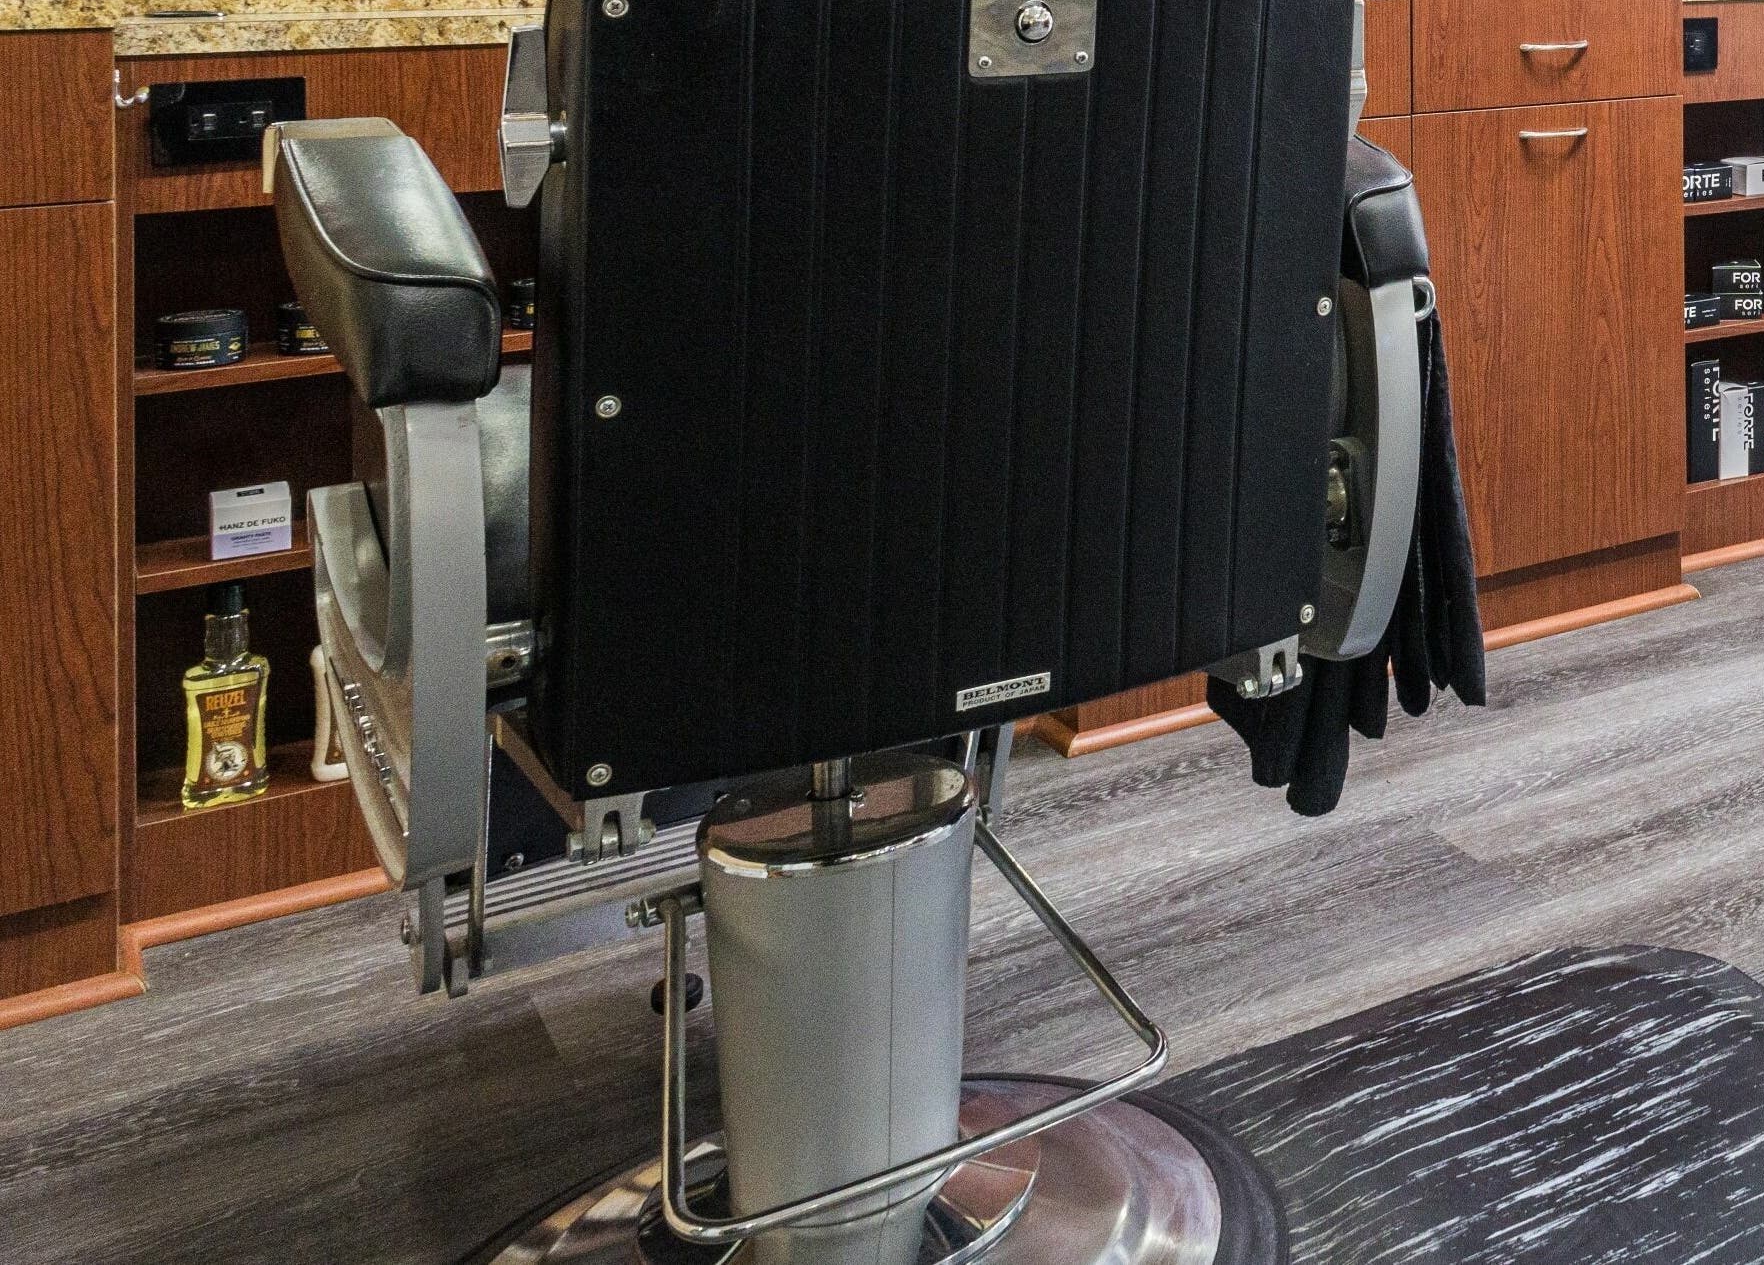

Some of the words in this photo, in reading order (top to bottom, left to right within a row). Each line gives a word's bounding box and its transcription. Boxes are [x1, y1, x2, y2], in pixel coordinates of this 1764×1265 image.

[1683, 173, 1720, 190] ORTE
[1684, 190, 1713, 198] eries
[1743, 392, 1754, 451] FORTE
[219, 522, 244, 531] HANZ
[261, 516, 286, 525] FUKO
[963, 677, 1044, 701] BELMONT
[963, 694, 1003, 708] PRODUCT
[1020, 685, 1045, 695] JAPAN
